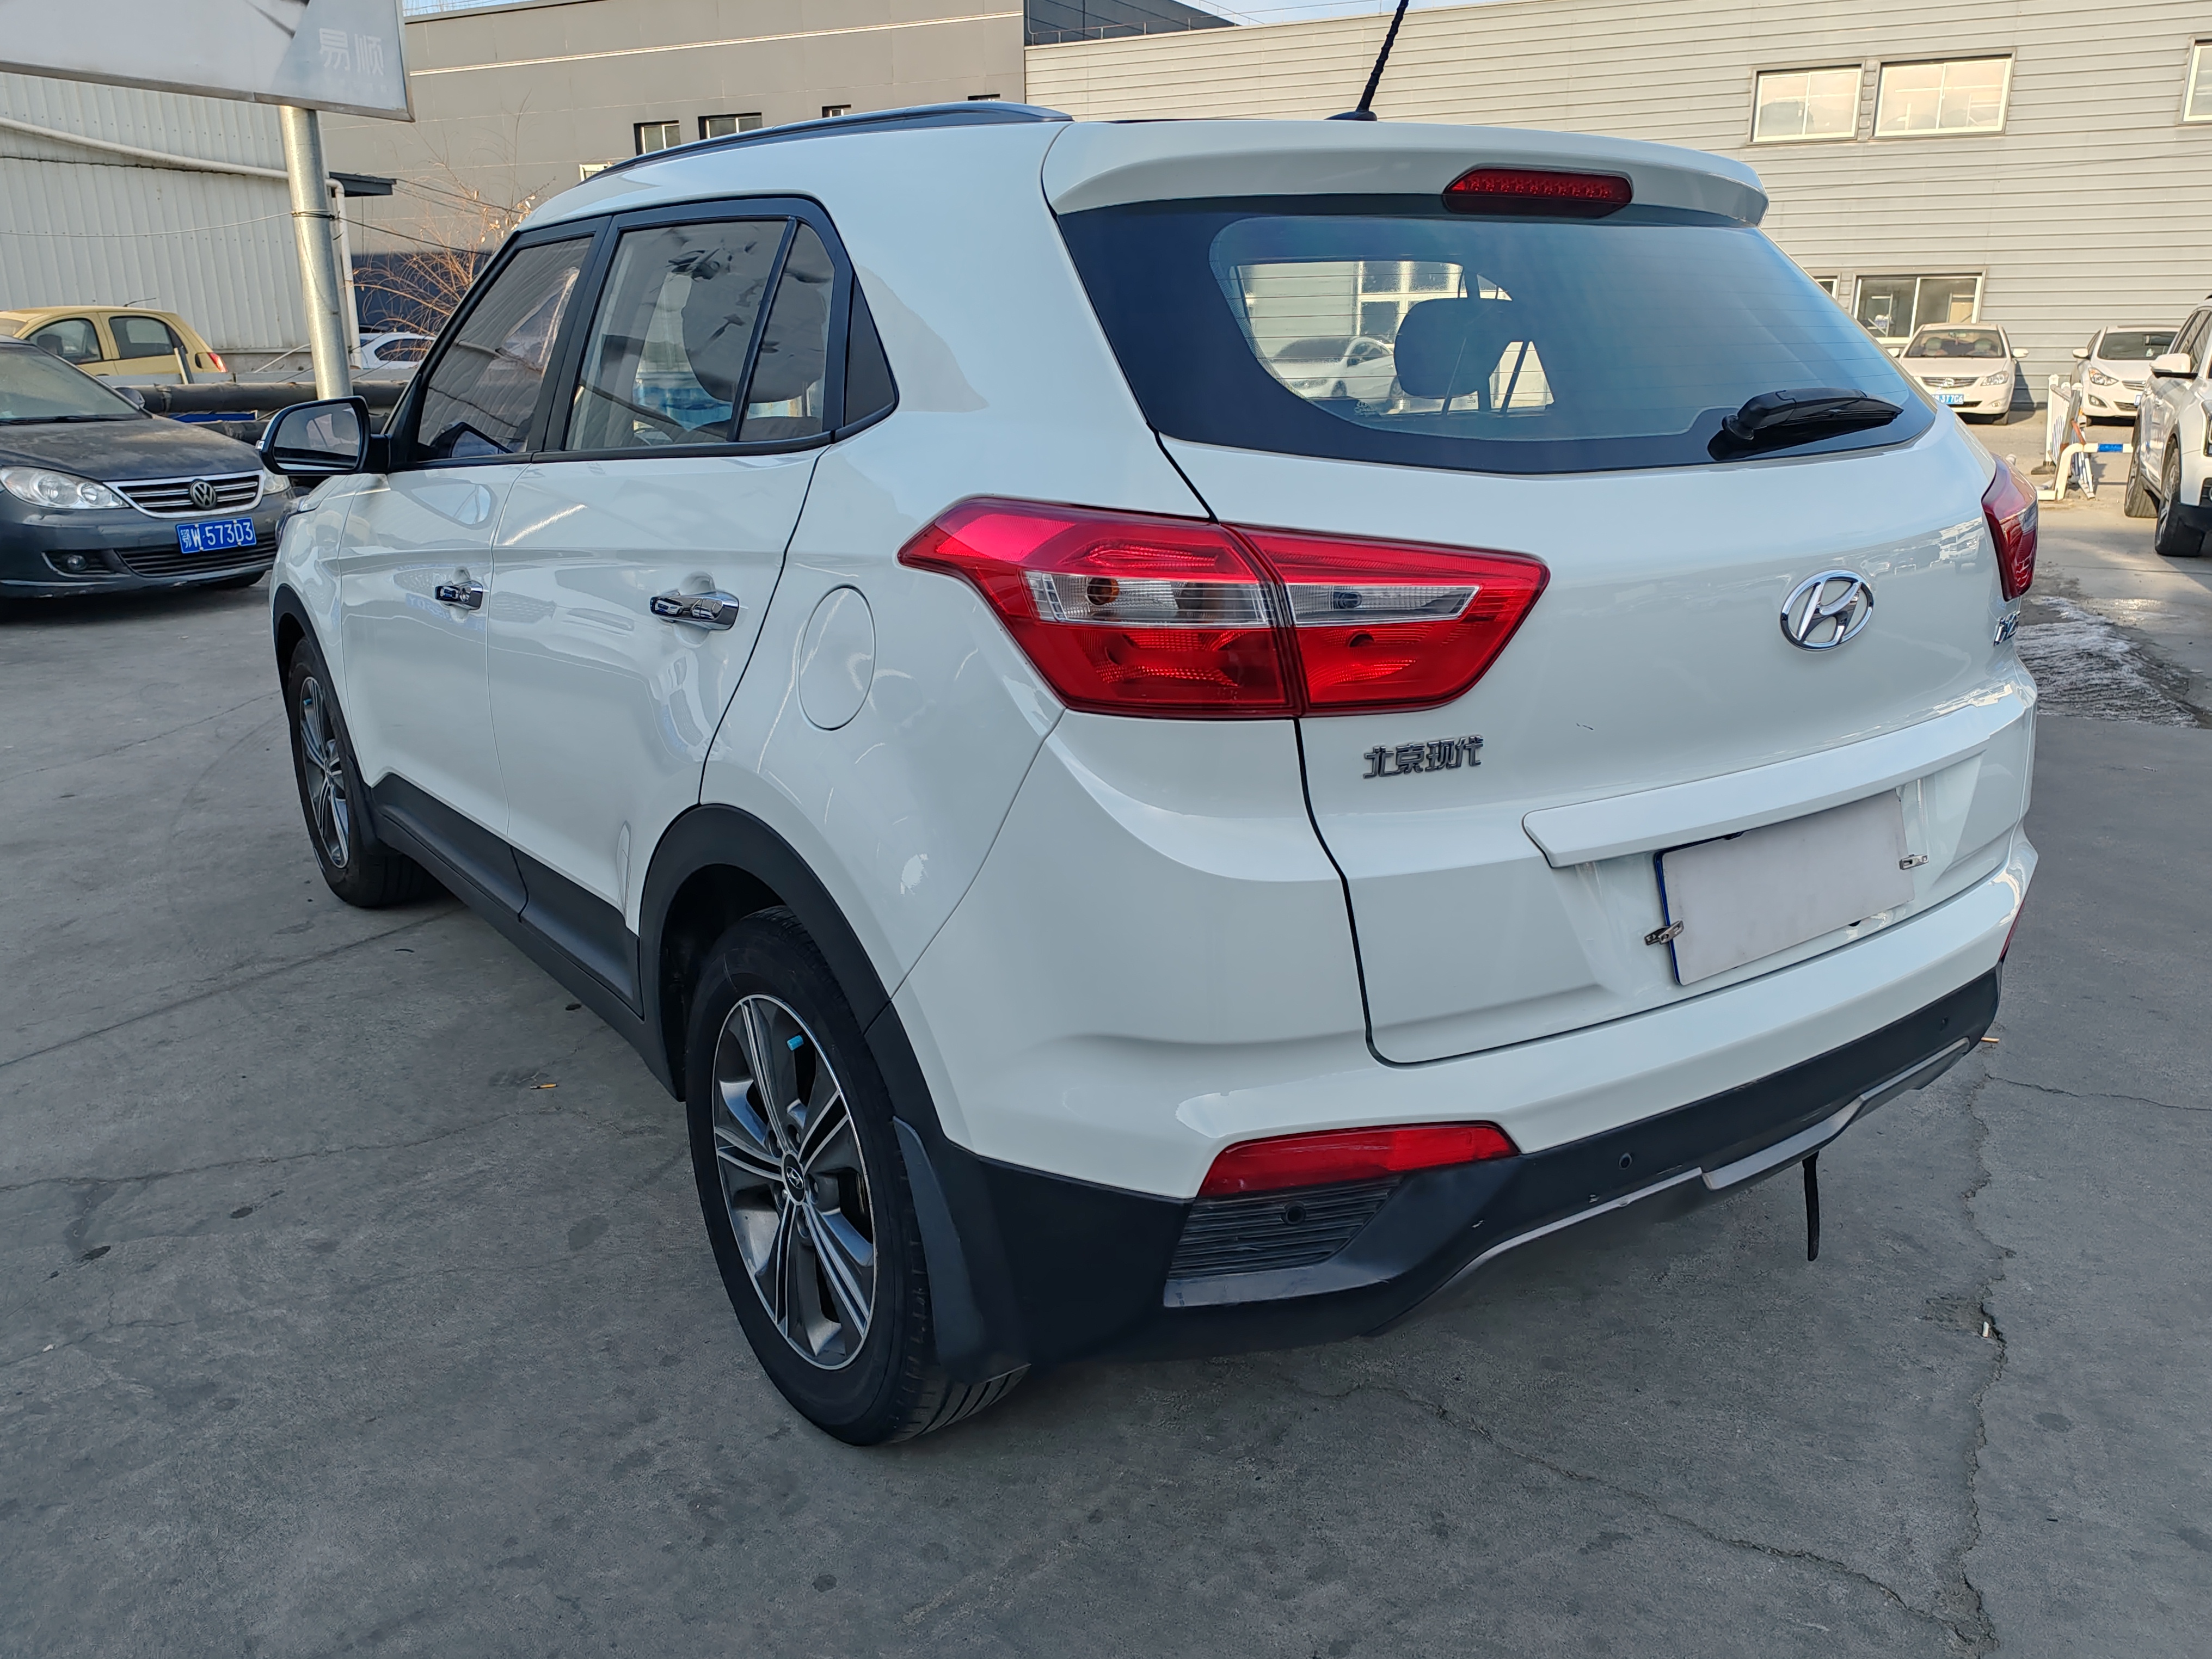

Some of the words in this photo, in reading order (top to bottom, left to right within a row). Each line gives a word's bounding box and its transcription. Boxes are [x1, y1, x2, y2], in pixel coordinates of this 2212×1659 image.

[319, 28, 384, 76] 易顺
[1363, 735, 1484, 779] 北京现代
